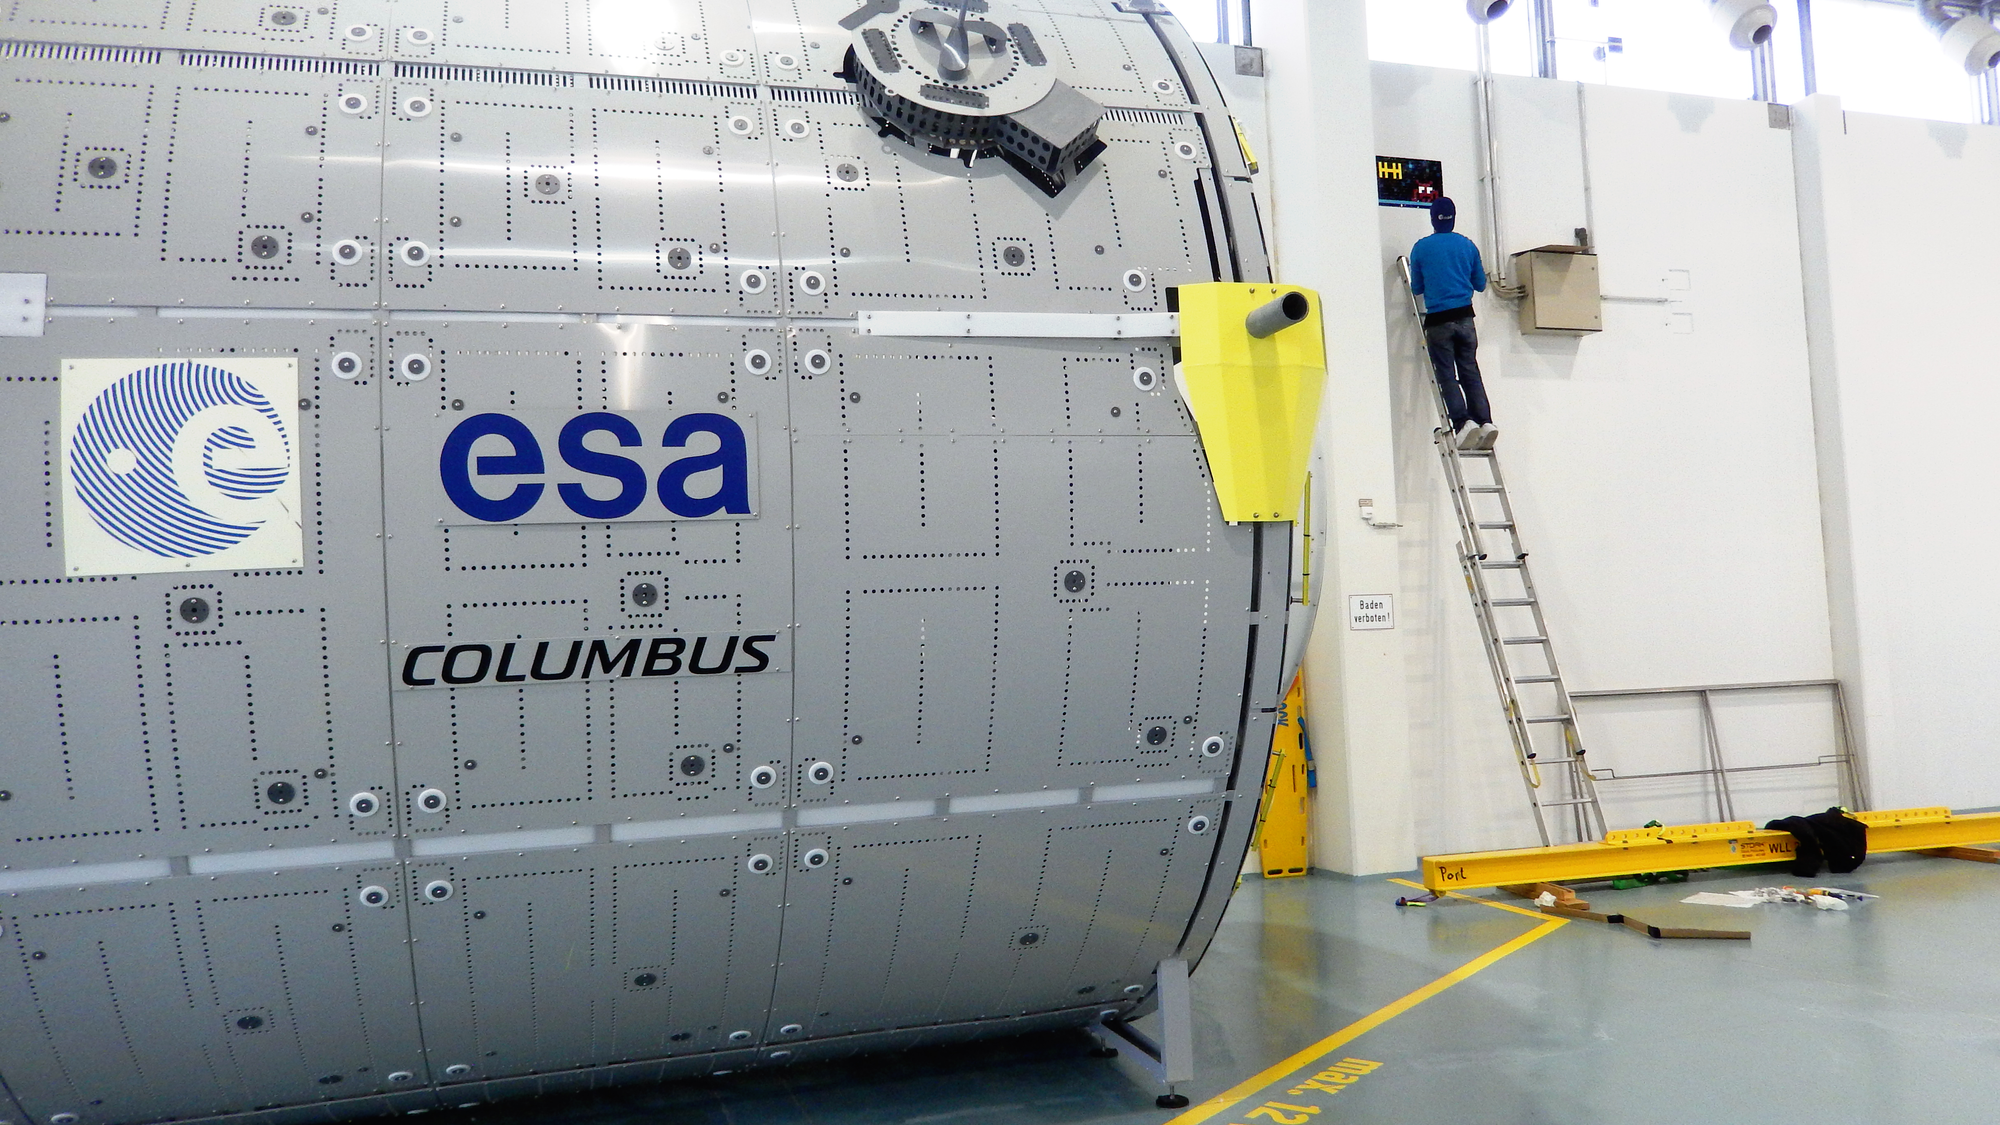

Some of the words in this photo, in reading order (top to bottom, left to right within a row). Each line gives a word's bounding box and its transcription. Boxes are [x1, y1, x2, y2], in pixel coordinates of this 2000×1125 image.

[440, 412, 751, 523] esa
[1359, 599, 1384, 610] Baden
[1353, 612, 1390, 623] verboten!
[402, 634, 777, 686] COLUMBUS
[1768, 843, 1792, 854] WLL
[1286, 1057, 1384, 1096] max.
[1244, 1101, 1322, 1125] 12
